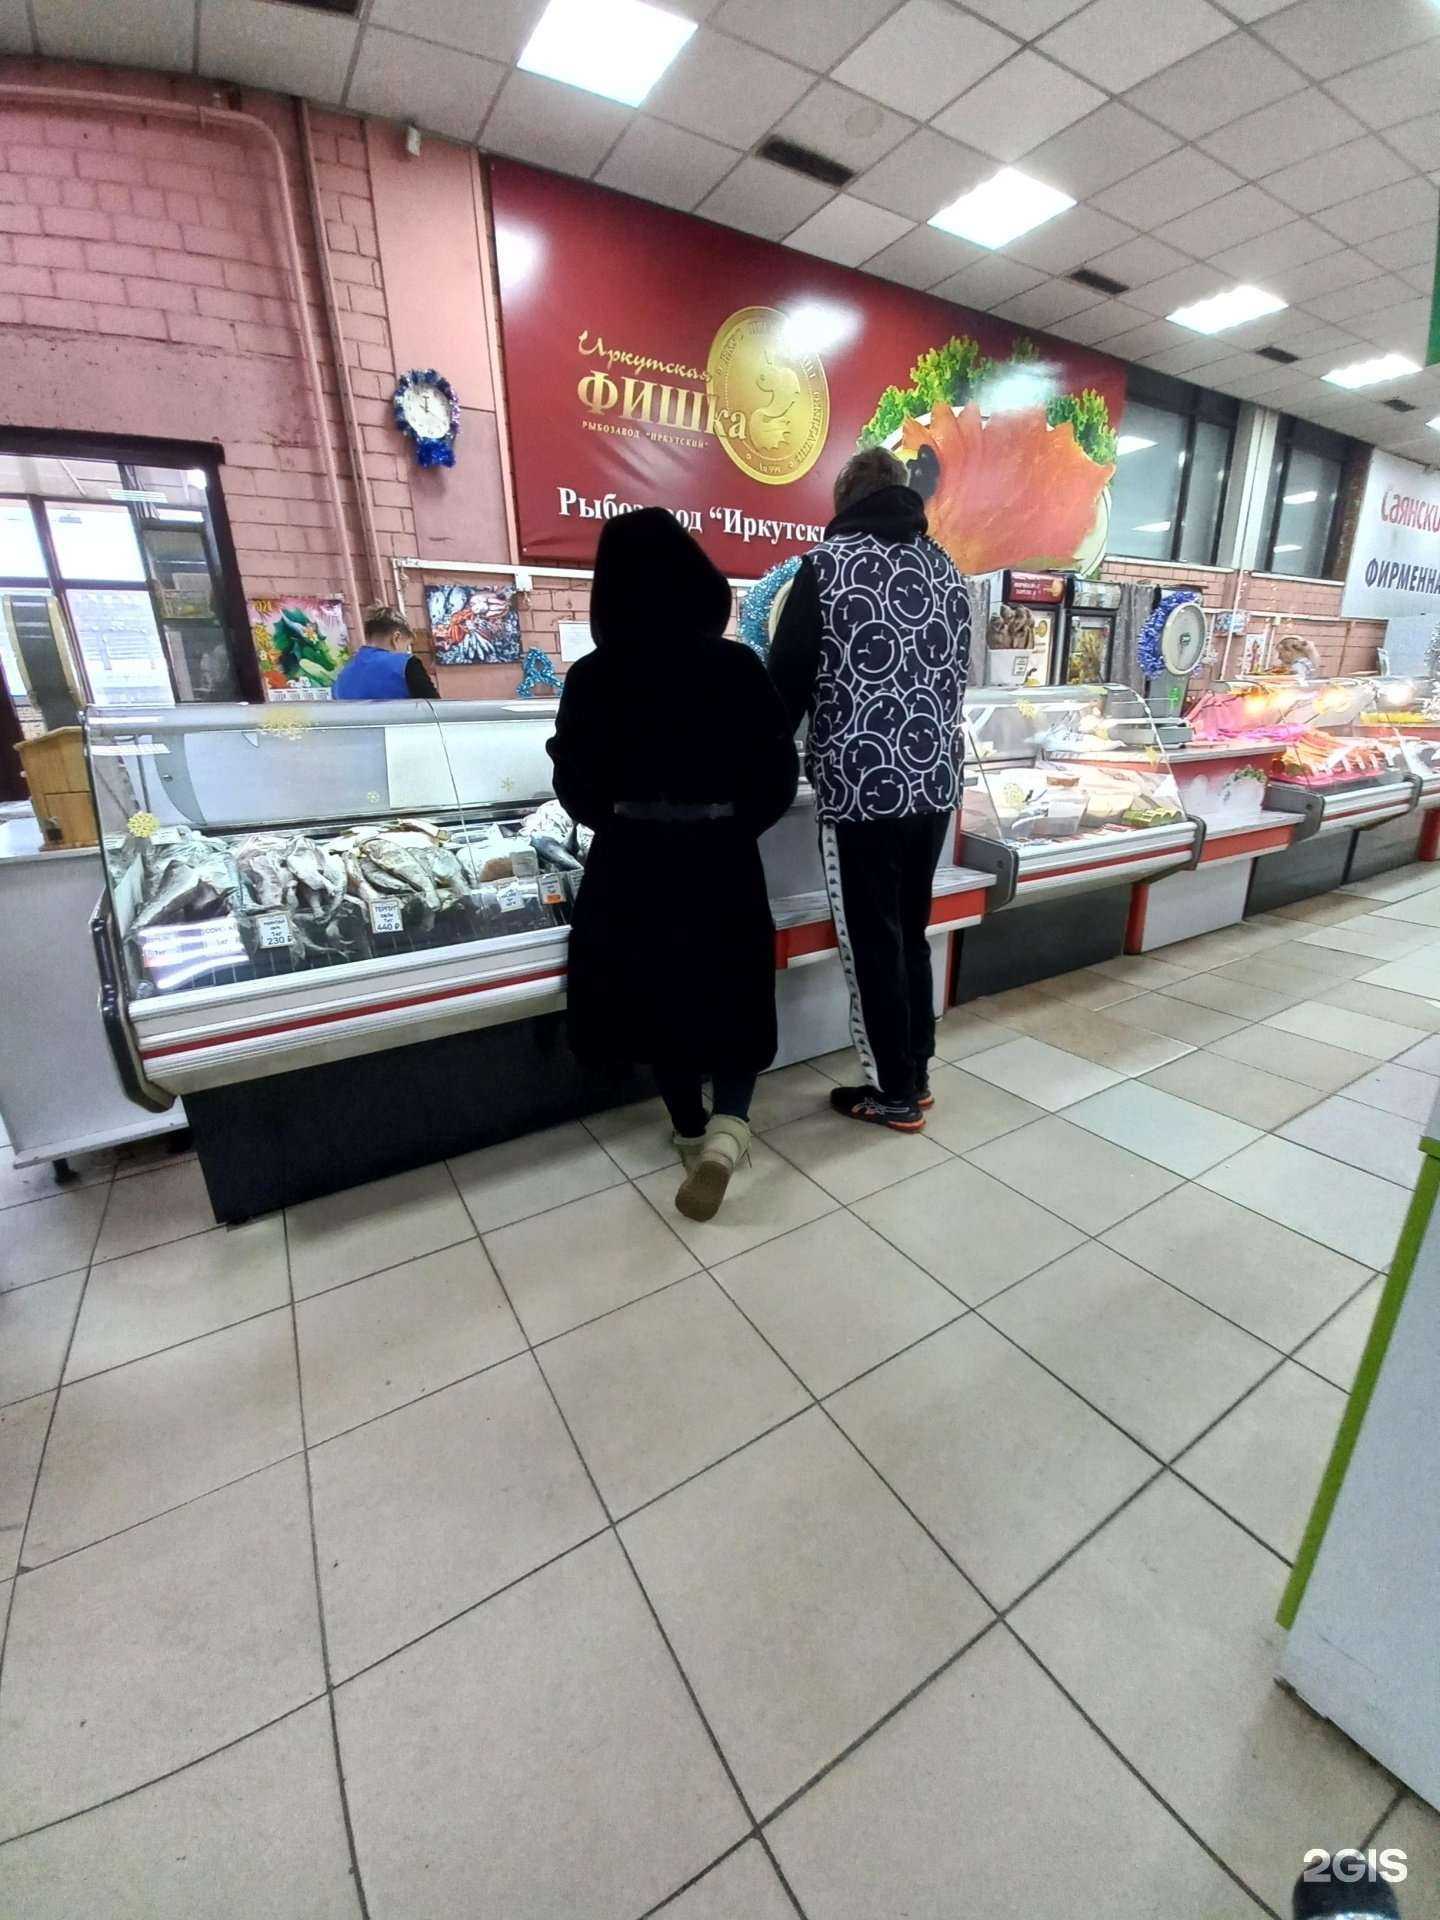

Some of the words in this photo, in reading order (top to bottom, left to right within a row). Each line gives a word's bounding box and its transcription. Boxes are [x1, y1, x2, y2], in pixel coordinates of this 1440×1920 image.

[582, 420, 640, 439] РЫБОЗАВОД
[557, 487, 703, 534] Рыбоод
[267, 935, 285, 945] 230
